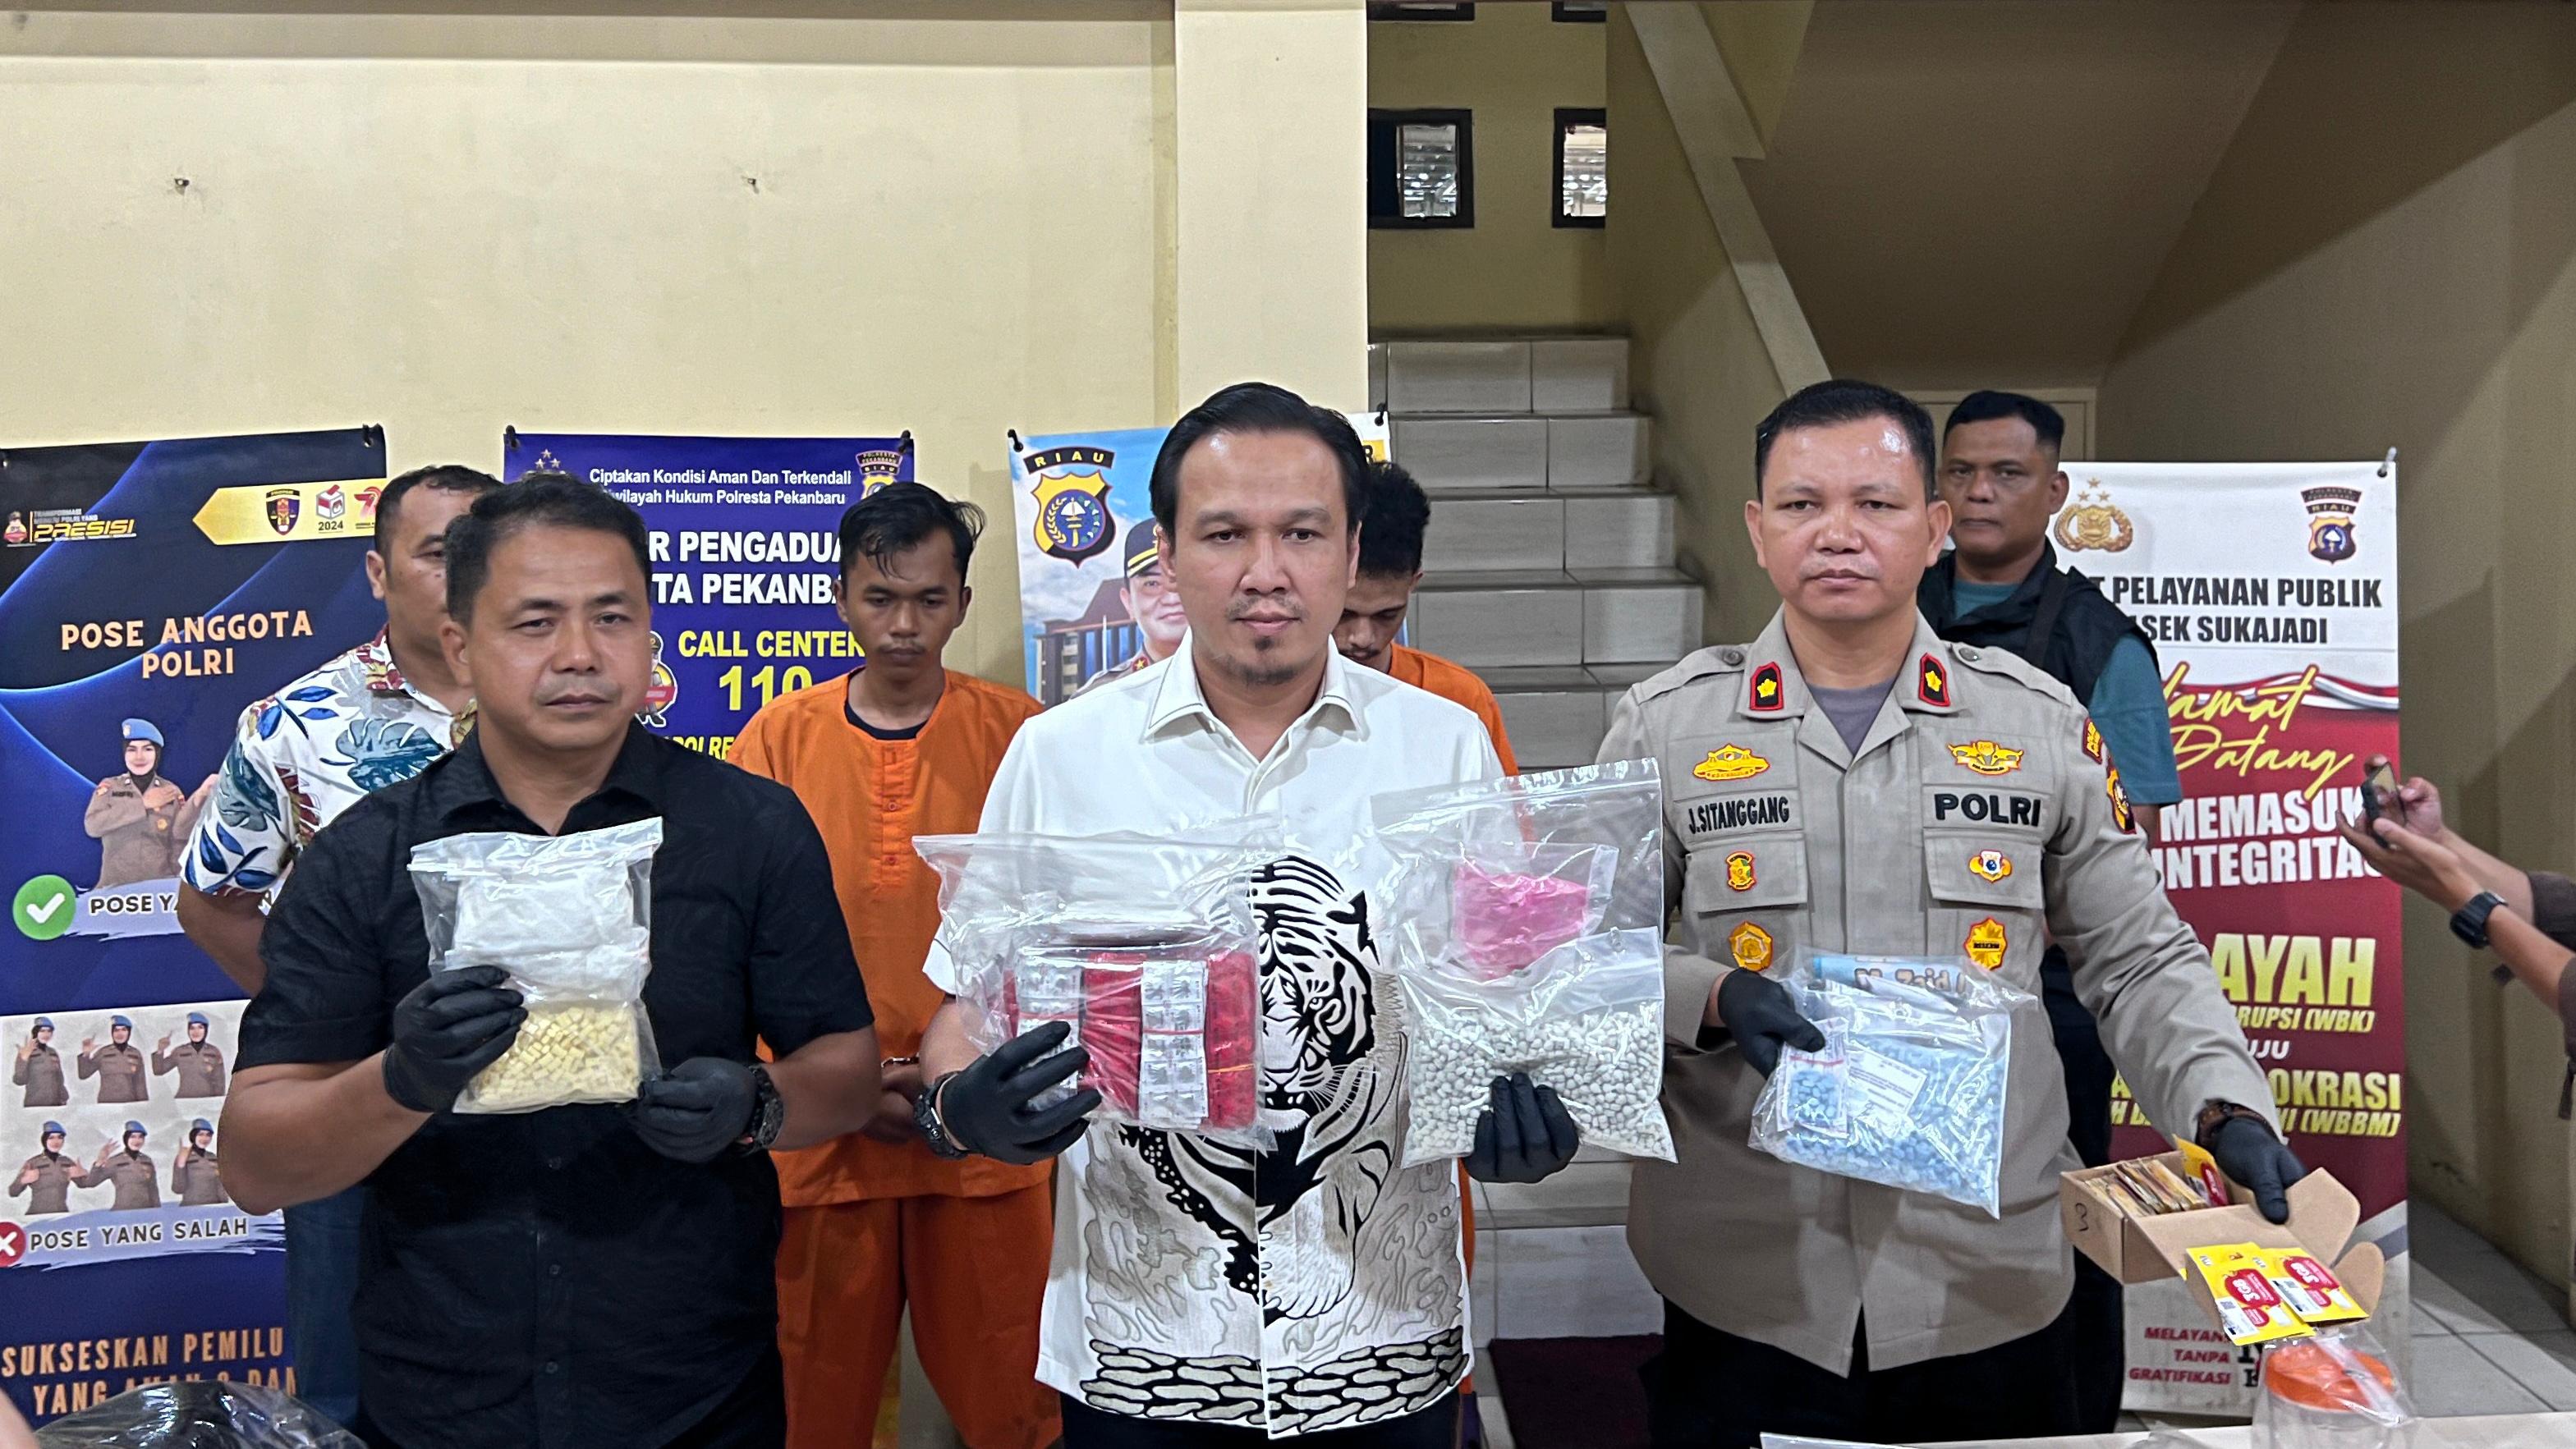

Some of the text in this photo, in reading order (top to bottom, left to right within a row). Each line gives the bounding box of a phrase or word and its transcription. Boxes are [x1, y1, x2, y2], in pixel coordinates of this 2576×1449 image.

[1035, 451, 1104, 468] RIAU
[589, 468, 852, 486] Ciptakan Kondisi Aman Dan Terkendali
[665, 490, 713, 503] Hukum
[716, 490, 771, 504] Polresta
[774, 490, 845, 505] Pekanbaru
[34, 519, 135, 539] PRESISI
[318, 520, 343, 531] 2024
[651, 573, 838, 604] TA PEKANB
[2112, 576, 2270, 606] PELAYANAN
[2277, 578, 2383, 608] PUBLIK
[62, 610, 314, 650] POSE ANGGOTA
[678, 630, 749, 658] CALL
[2137, 615, 2328, 644] SEK SUKAJADI
[142, 647, 234, 679] POLRI
[2170, 724, 2355, 800] Datang
[1688, 796, 1790, 835] J.SITANGGANG
[1934, 793, 2041, 827] POLRI
[90, 896, 152, 914] POSE
[2211, 933, 2376, 1007] AYAH
[2235, 1006, 2376, 1034] RUPSI (WBK)
[2268, 1068, 2401, 1111] OKRASI
[2301, 1109, 2401, 1138] (WBBM)
[30, 1217, 247, 1250] POSE YANG SALAH
[1, 1327, 284, 1378] SUKSESKAN PEMILU
[2174, 1349, 2229, 1364] TANPA
[2129, 1367, 2232, 1385] GRATIFIKASI
[33, 1380, 108, 1416] YANG
